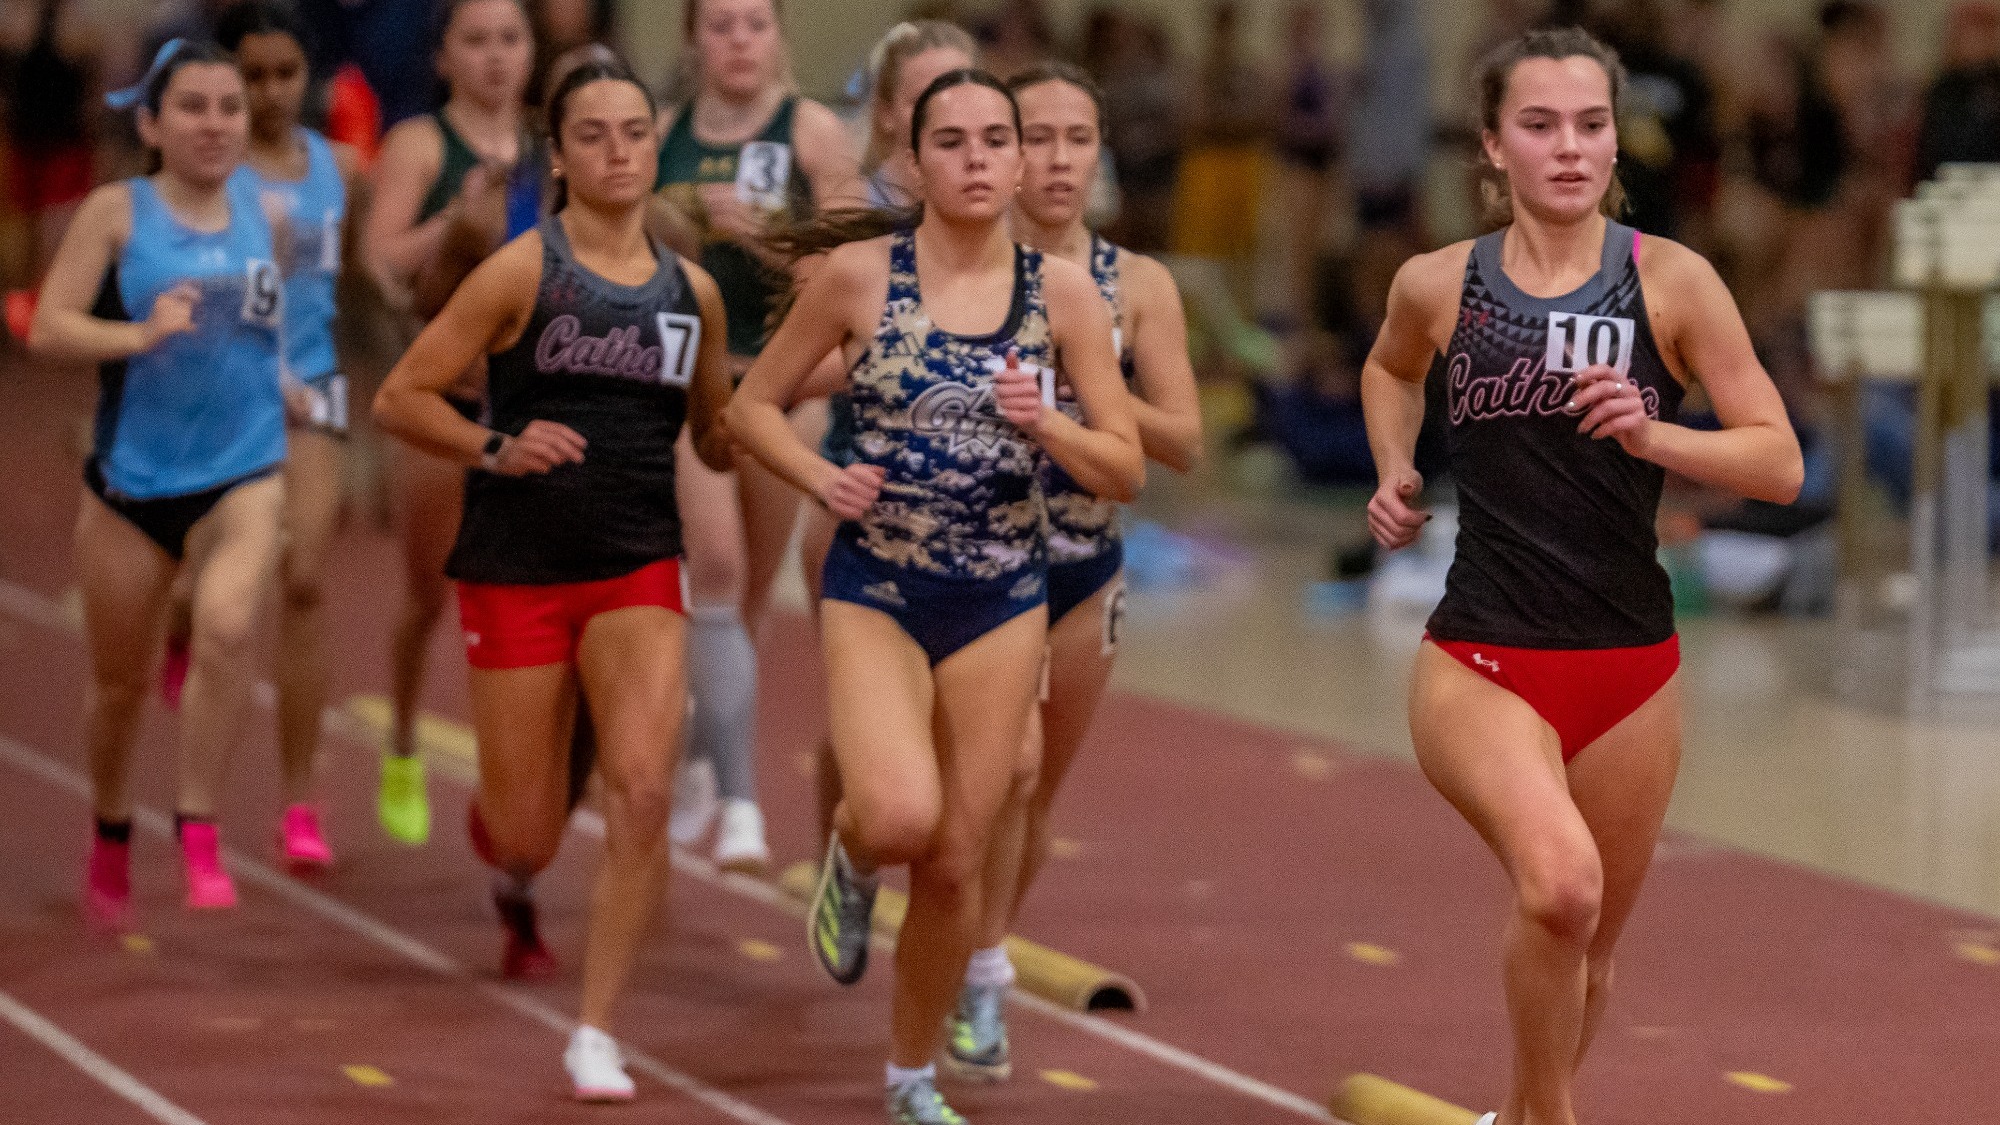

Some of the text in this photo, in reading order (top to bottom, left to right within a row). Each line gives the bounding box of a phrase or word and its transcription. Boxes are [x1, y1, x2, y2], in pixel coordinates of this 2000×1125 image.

[749, 144, 777, 193] 3
[252, 265, 278, 317] 9
[535, 314, 664, 383] Catho
[667, 320, 692, 376] 7
[1555, 315, 1621, 370] 10
